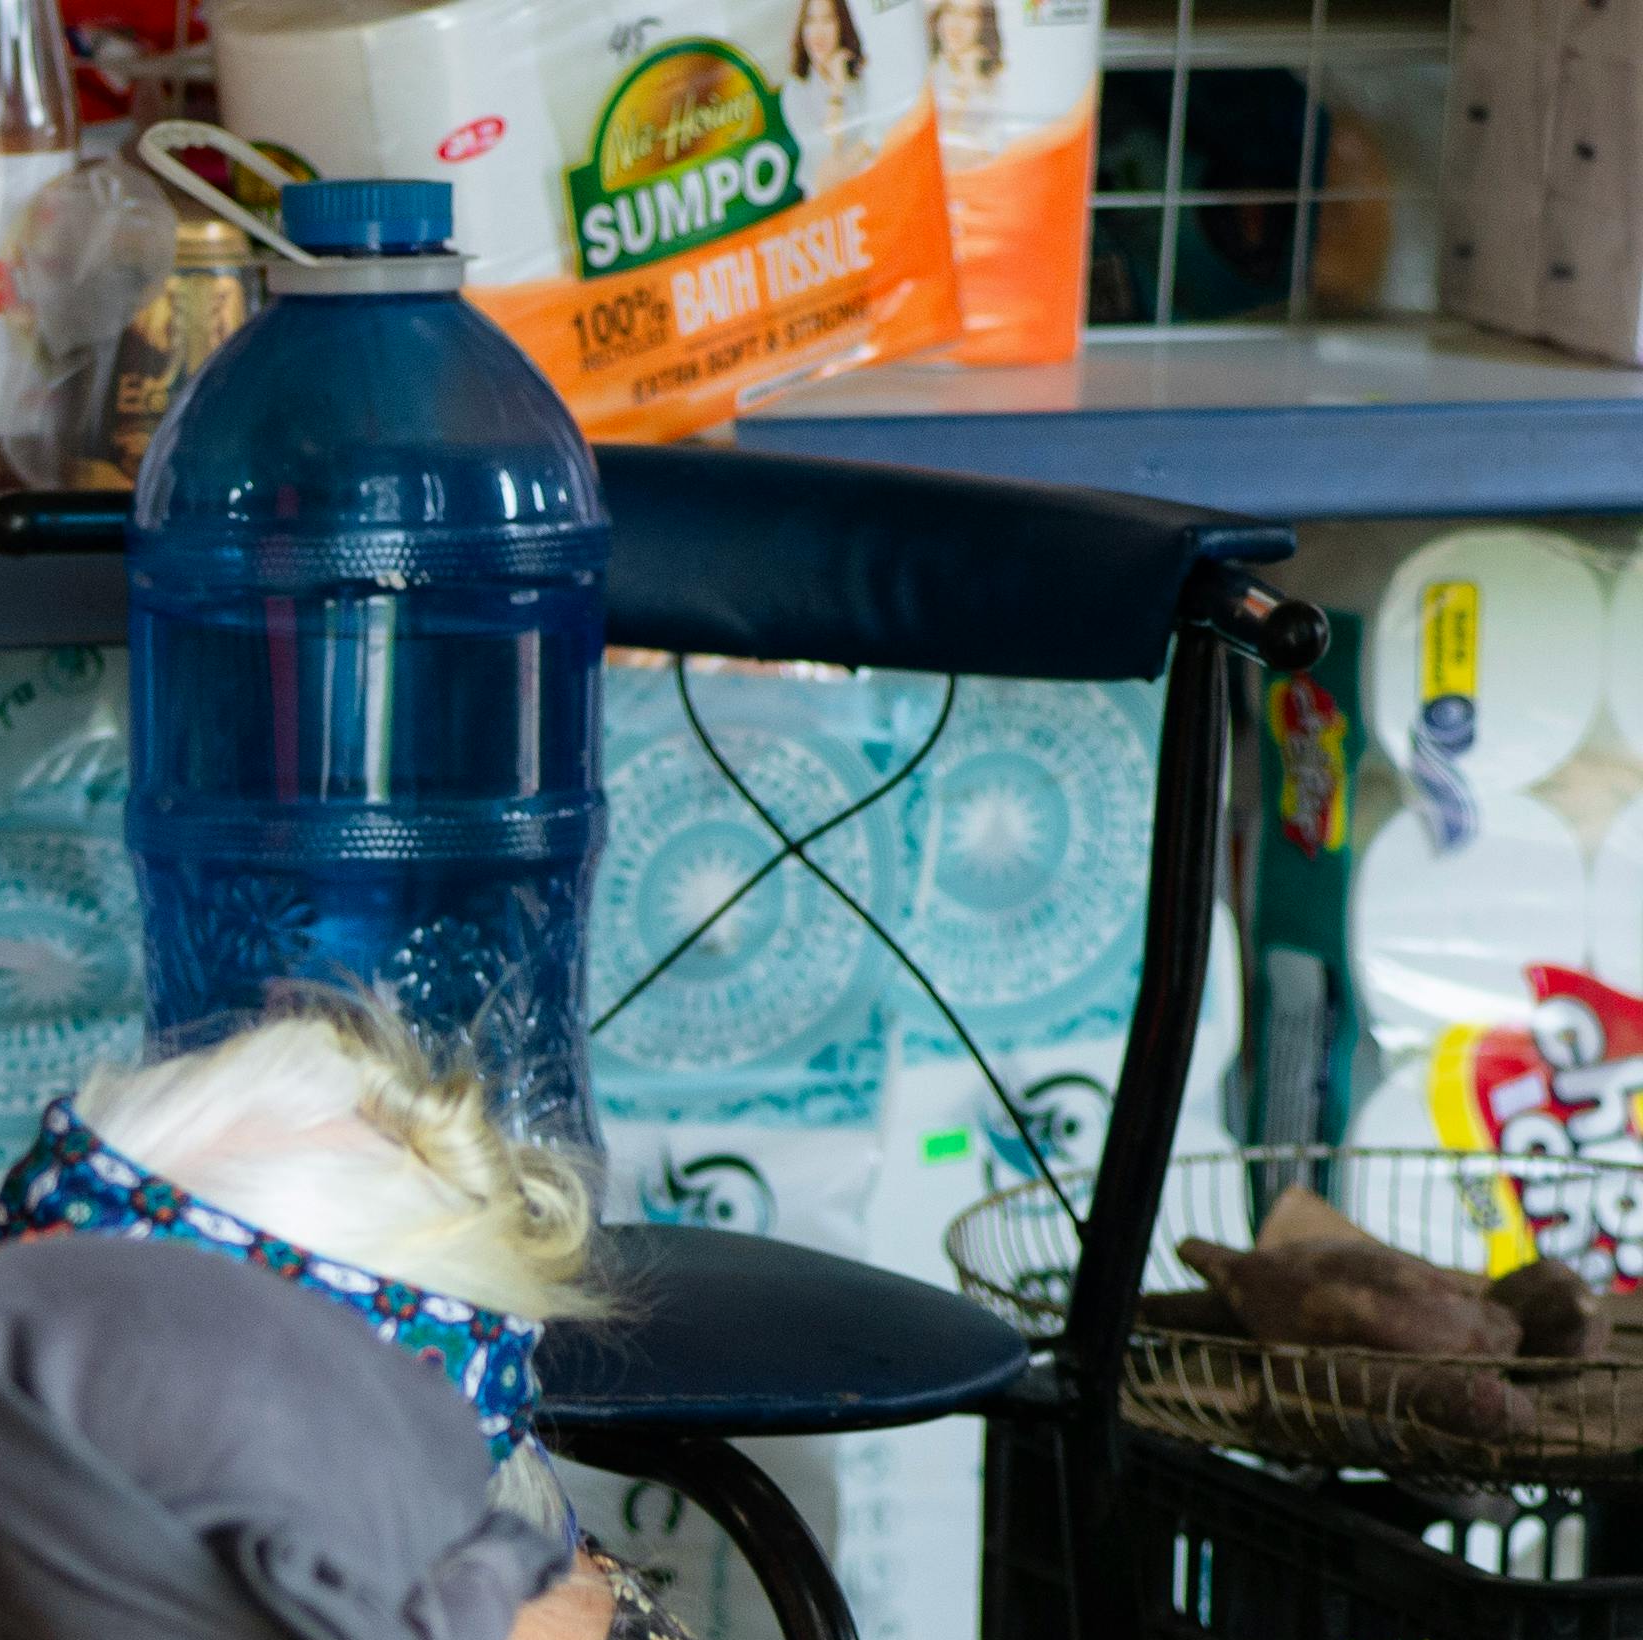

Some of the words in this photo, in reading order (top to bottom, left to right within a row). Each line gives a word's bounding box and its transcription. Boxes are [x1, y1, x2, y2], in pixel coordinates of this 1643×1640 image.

[582, 140, 792, 270] SUMPO
[671, 249, 760, 337] BATH
[756, 204, 874, 303] TISSUE
